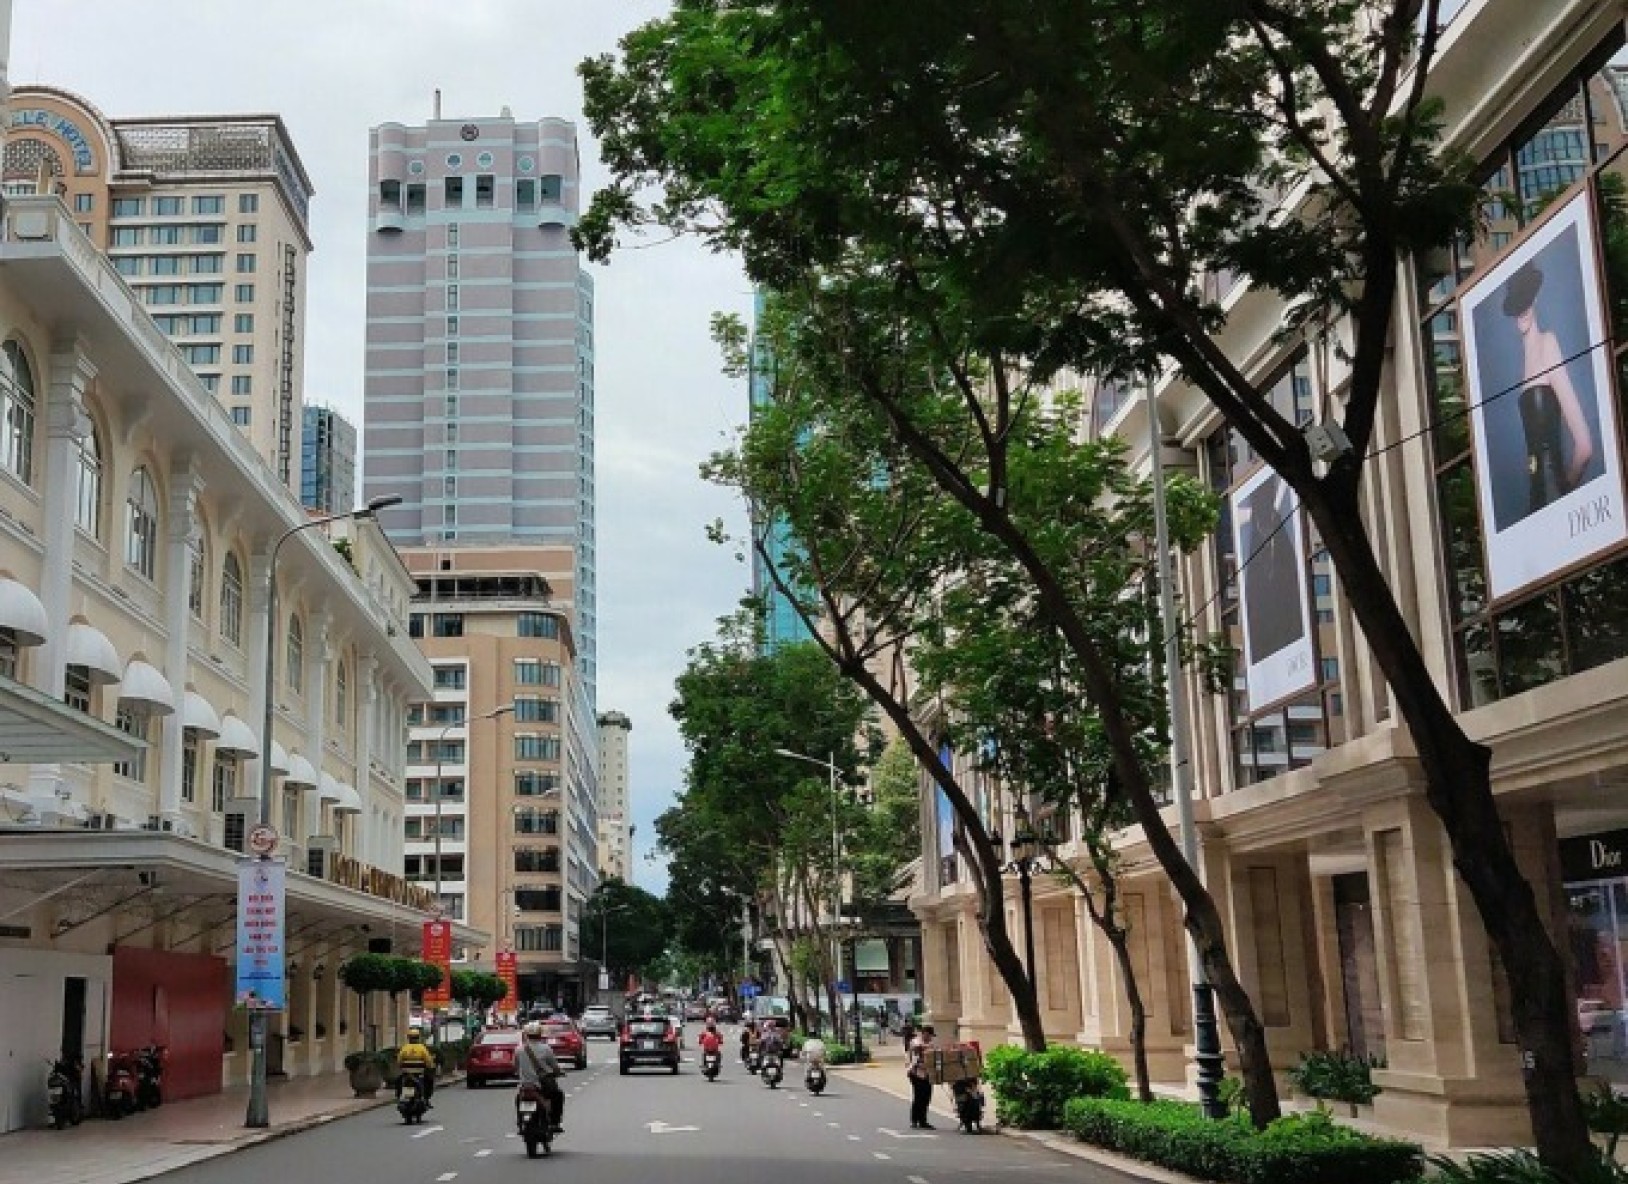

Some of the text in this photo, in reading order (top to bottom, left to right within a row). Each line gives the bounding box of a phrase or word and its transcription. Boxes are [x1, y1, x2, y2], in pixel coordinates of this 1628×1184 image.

[55, 119, 91, 172] HOTEL
[1567, 495, 1612, 539] DIOR
[1589, 840, 1622, 869] Dior
